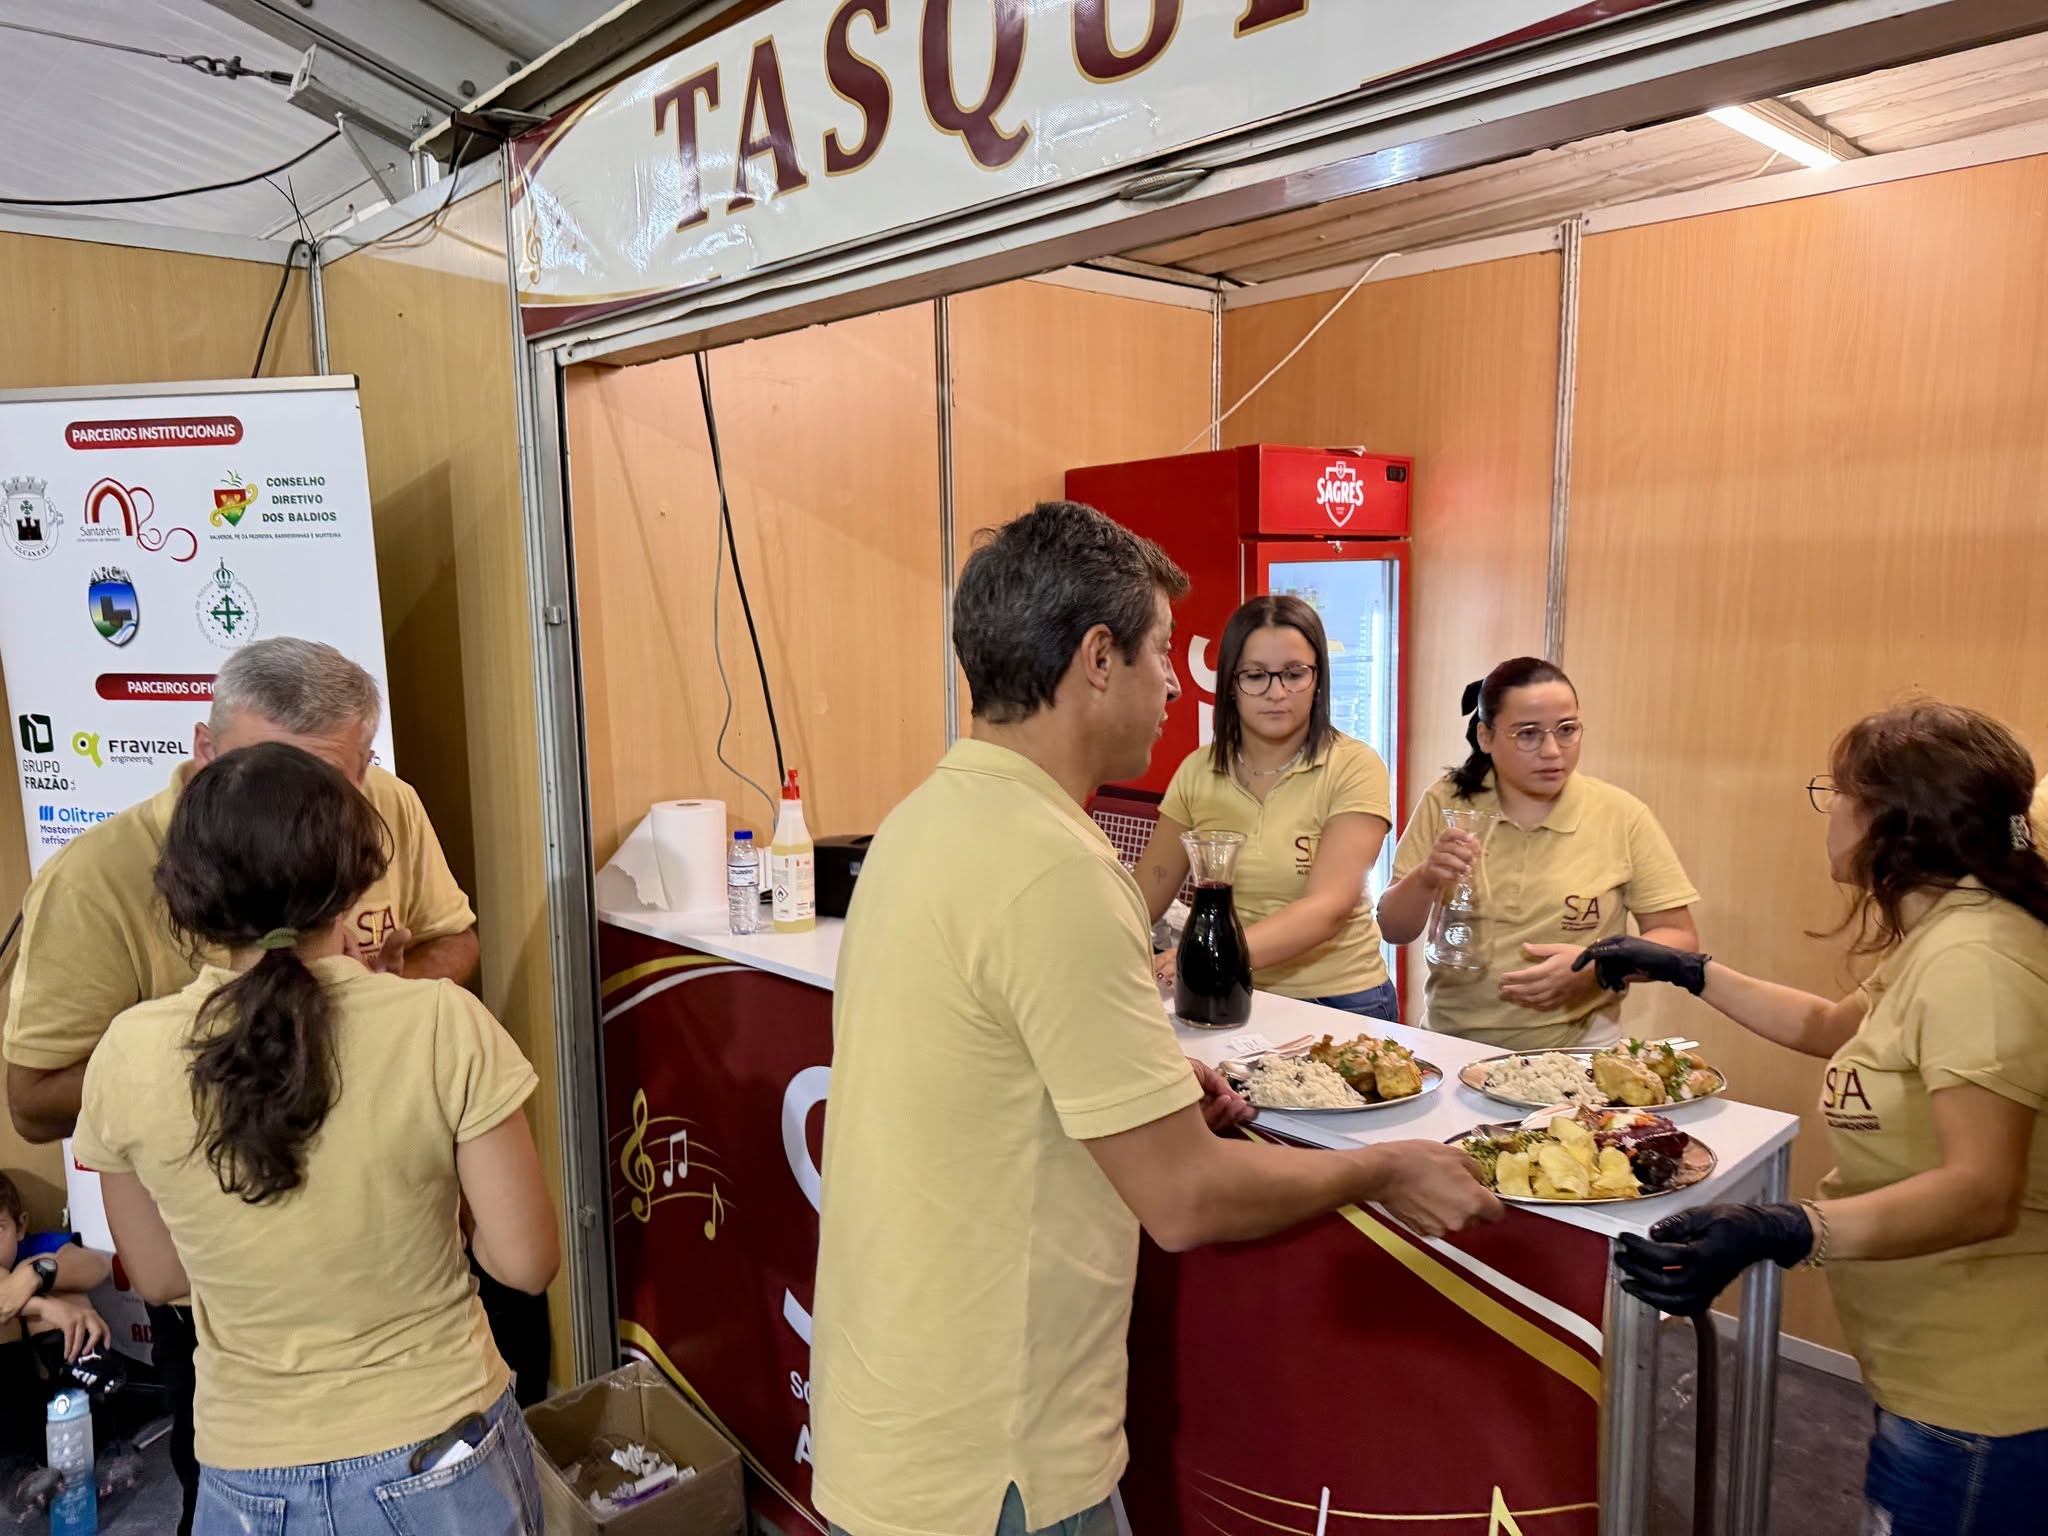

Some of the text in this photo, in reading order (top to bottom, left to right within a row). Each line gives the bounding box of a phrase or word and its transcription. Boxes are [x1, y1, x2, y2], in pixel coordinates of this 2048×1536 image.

[653, 0, 1308, 234] TASQ
[72, 422, 236, 444] PARCEIROS INSTITUCIONAIS
[266, 475, 326, 488] CONSELHO
[1316, 477, 1364, 507] SAGRES
[272, 494, 324, 505] DIRETIVO
[262, 511, 337, 523] DOS BALDIOS
[79, 525, 120, 537] Santarém
[89, 565, 133, 585] ARCA
[127, 681, 189, 695] PARCEIROS
[23, 760, 61, 774] GRUPO
[110, 755, 154, 766] engineering
[24, 775, 69, 791] FRAZÃO
